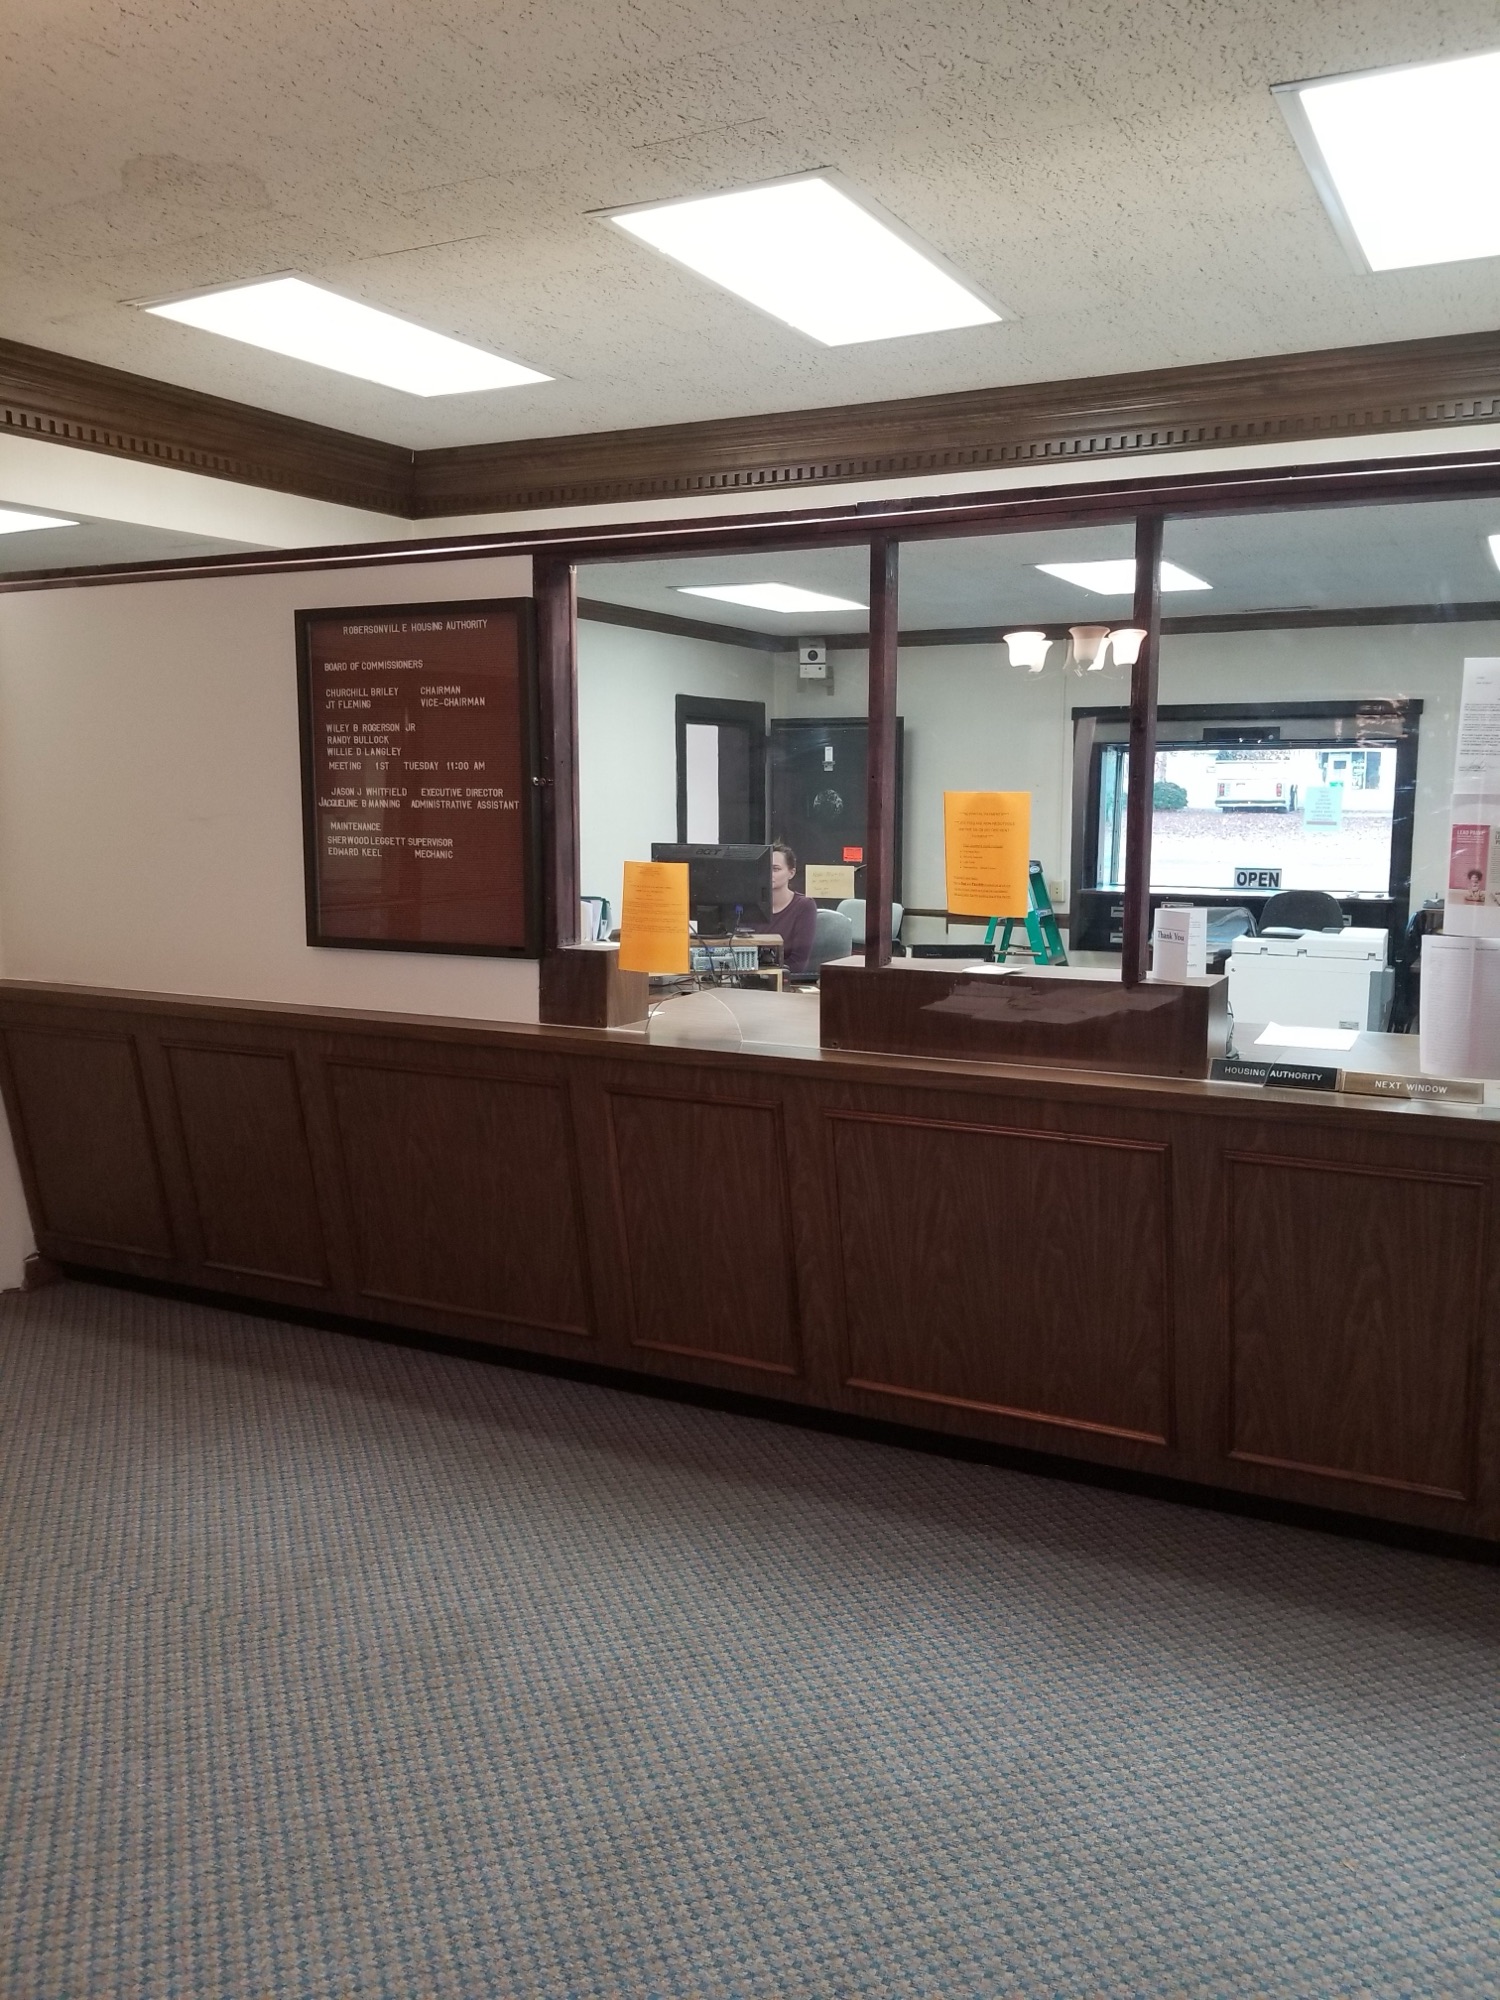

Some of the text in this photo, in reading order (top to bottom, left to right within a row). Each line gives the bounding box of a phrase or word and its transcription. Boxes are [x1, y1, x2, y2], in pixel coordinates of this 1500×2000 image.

[343, 619, 488, 635] ROBERSONVILLE HOUSING AUTHORITY
[324, 660, 423, 671] BOARD OF COMMISSIONERS
[325, 686, 461, 697] CHURCHILL BRILEY CHAIRMAN
[325, 698, 485, 709] JT FLEMING VICE-CHAIRMAN
[326, 723, 416, 732] WILEY B ROGERSON JR
[327, 735, 389, 744] RANDY BULLOCK
[326, 748, 402, 756] WILLIE D LANGLEY
[328, 762, 486, 770] MEETING 1ST TUESDAY 11:00 AM
[331, 787, 504, 797] JASON J WHITFIELD EXECUTIVE DIRECTOR
[318, 797, 358, 808] JACQUELINE
[368, 799, 400, 808] MANNING
[411, 800, 472, 809] ADMINISTRATIVE
[477, 800, 519, 810] ASSISTANT
[330, 822, 381, 831] MAINTENANCE
[327, 836, 454, 847] SHERWOOD LEGGETT SUPERVISOR
[328, 847, 454, 859] EDWARD KEEL MECHANIC
[1236, 871, 1279, 888] OPEN
[1157, 930, 1184, 941] Thank You
[1224, 1066, 1323, 1081] HOUSING AUTHORITY
[1374, 1079, 1448, 1094] NEXT WINDOW
